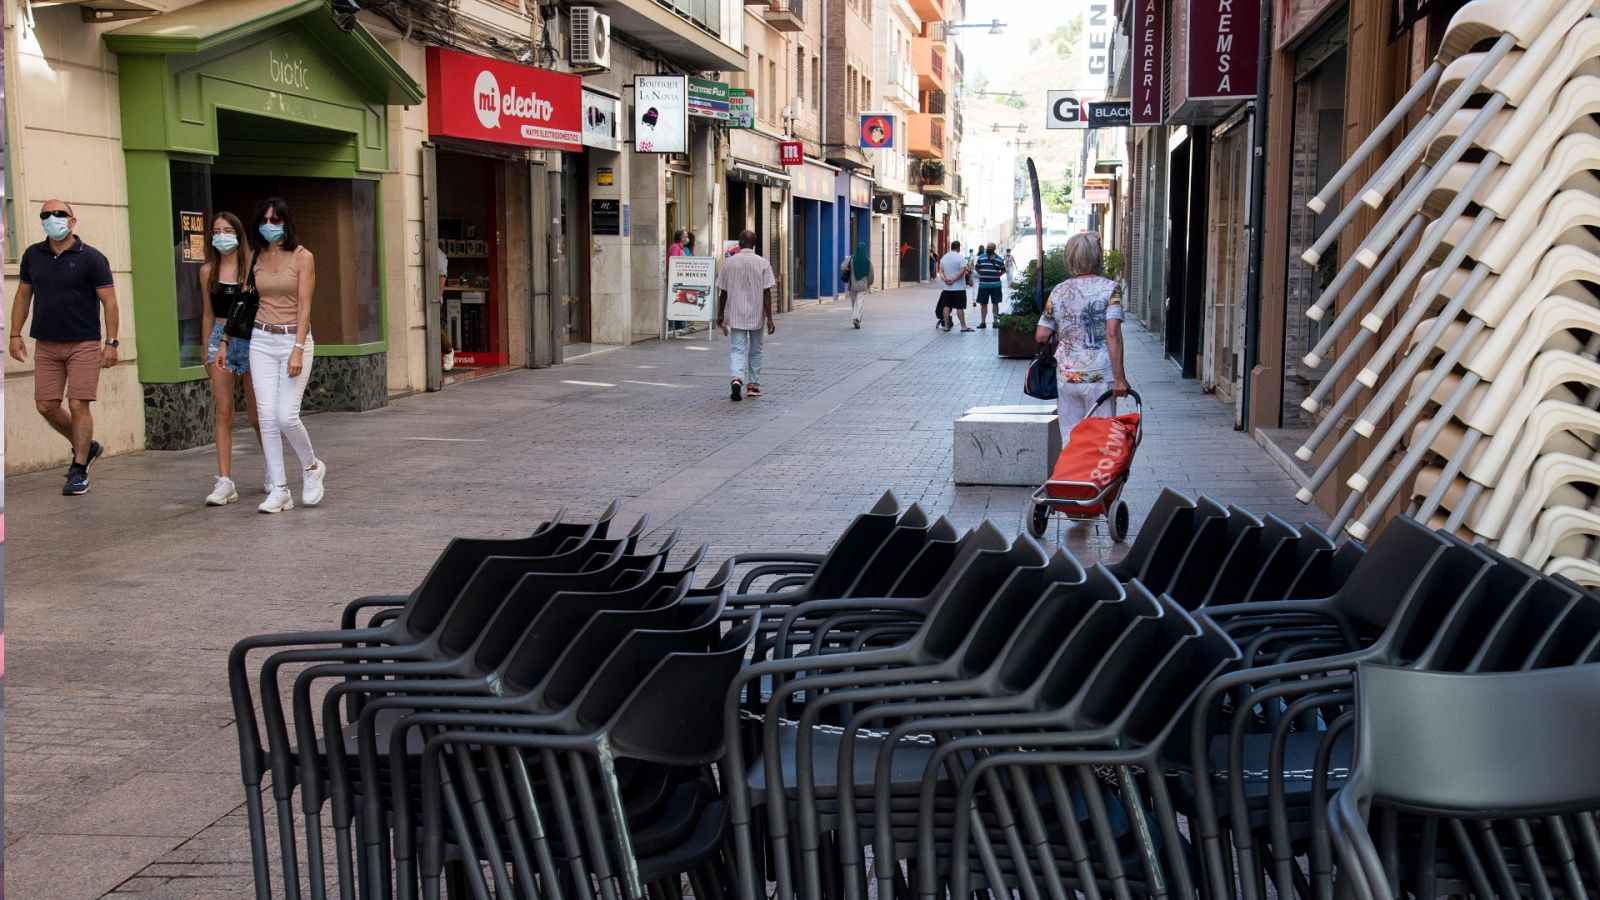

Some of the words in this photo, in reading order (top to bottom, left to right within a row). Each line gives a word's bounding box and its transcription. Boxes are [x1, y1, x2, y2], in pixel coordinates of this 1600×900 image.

[1142, 0, 1154, 116] APERERIA
[479, 87, 496, 112] mi
[502, 86, 554, 122] electro
[454, 356, 475, 364] EVISIÓ
